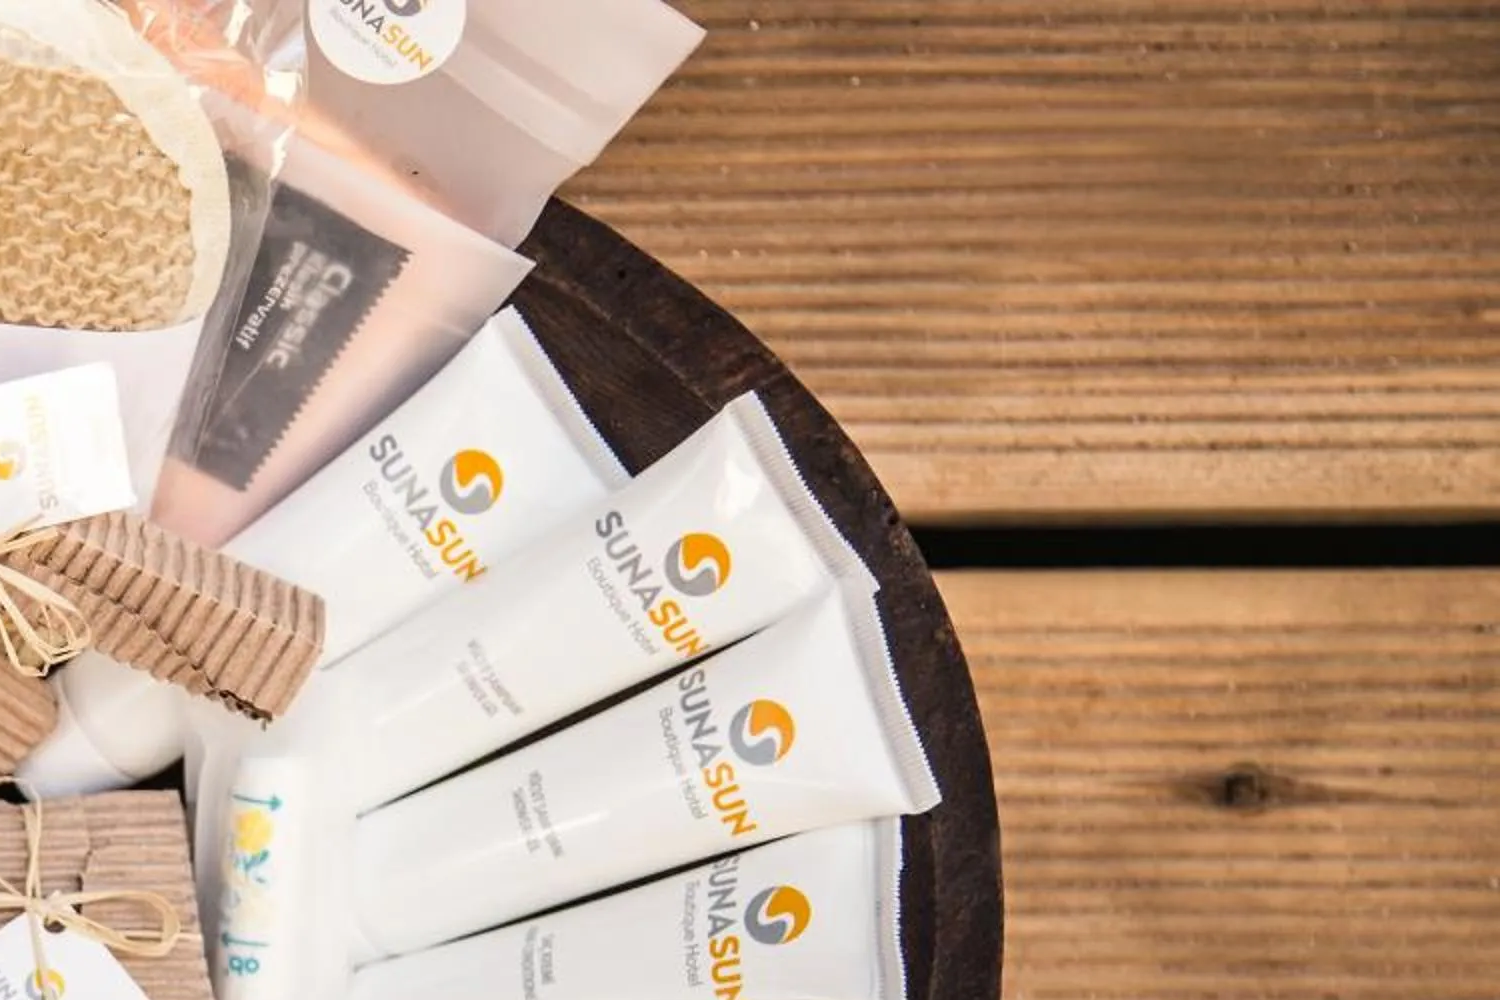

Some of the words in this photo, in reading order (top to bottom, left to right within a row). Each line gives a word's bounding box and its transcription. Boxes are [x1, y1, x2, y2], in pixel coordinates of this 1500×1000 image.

[341, 0, 433, 71] NASUN
[266, 262, 354, 369] Classic
[369, 434, 489, 583] SUNASUN
[586, 556, 632, 623] Boutique
[627, 619, 657, 655] Hotel
[595, 510, 712, 657] SUNASUN
[658, 706, 687, 779] Boutique
[679, 777, 709, 820] Hotel
[678, 668, 758, 836] SUNASUN
